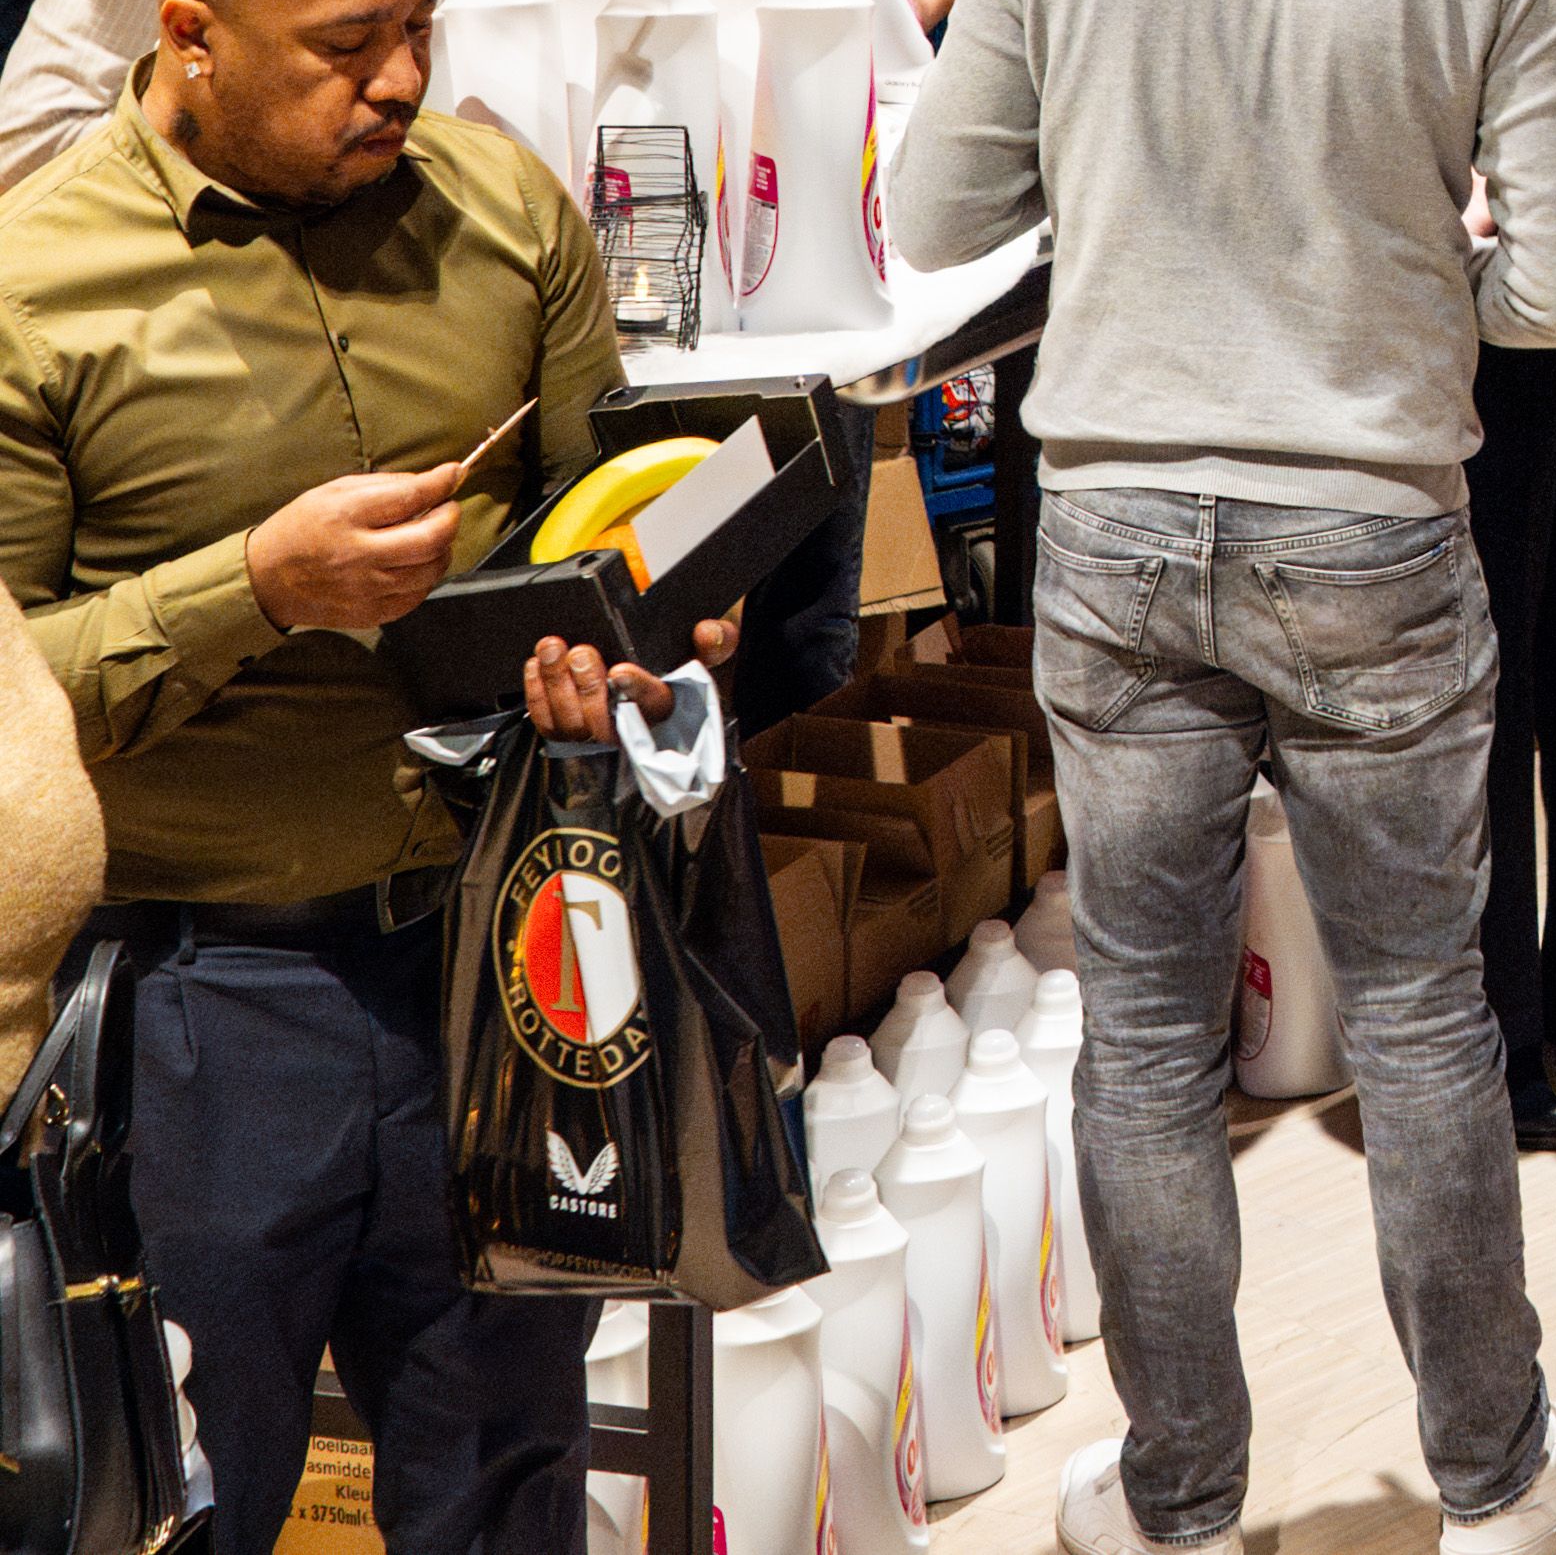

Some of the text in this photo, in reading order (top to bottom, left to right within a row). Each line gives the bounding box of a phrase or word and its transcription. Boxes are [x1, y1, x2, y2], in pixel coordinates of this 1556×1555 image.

[549, 1195, 617, 1219] CASTORE
[312, 1436, 374, 1455] loeibaar
[307, 1462, 371, 1479] asmidde
[336, 1485, 370, 1501] Kleu
